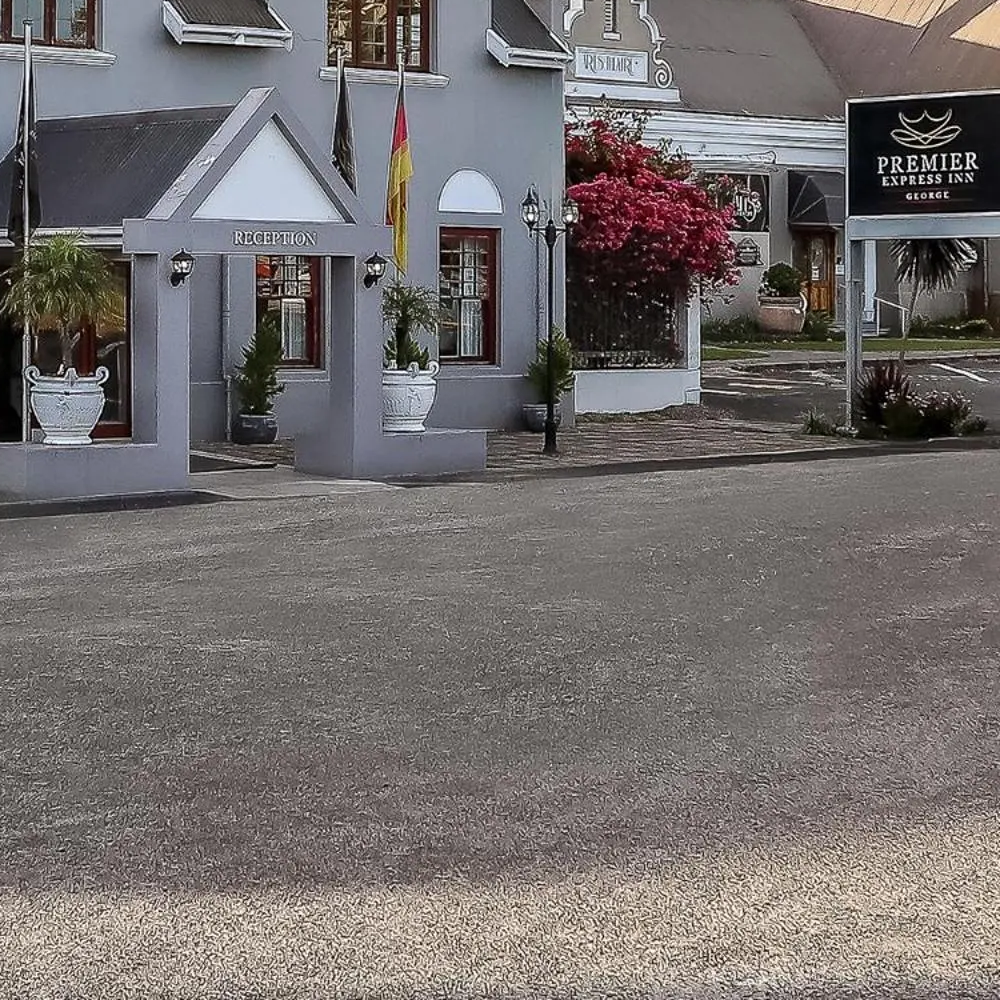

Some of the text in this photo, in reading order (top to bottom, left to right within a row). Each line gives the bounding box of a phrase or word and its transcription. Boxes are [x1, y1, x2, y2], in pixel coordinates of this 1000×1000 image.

[877, 151, 979, 174] PREMIER
[882, 172, 975, 187] EXPRESS INN
[905, 191, 950, 201] GEORGE
[233, 231, 317, 246] RECEPTION
